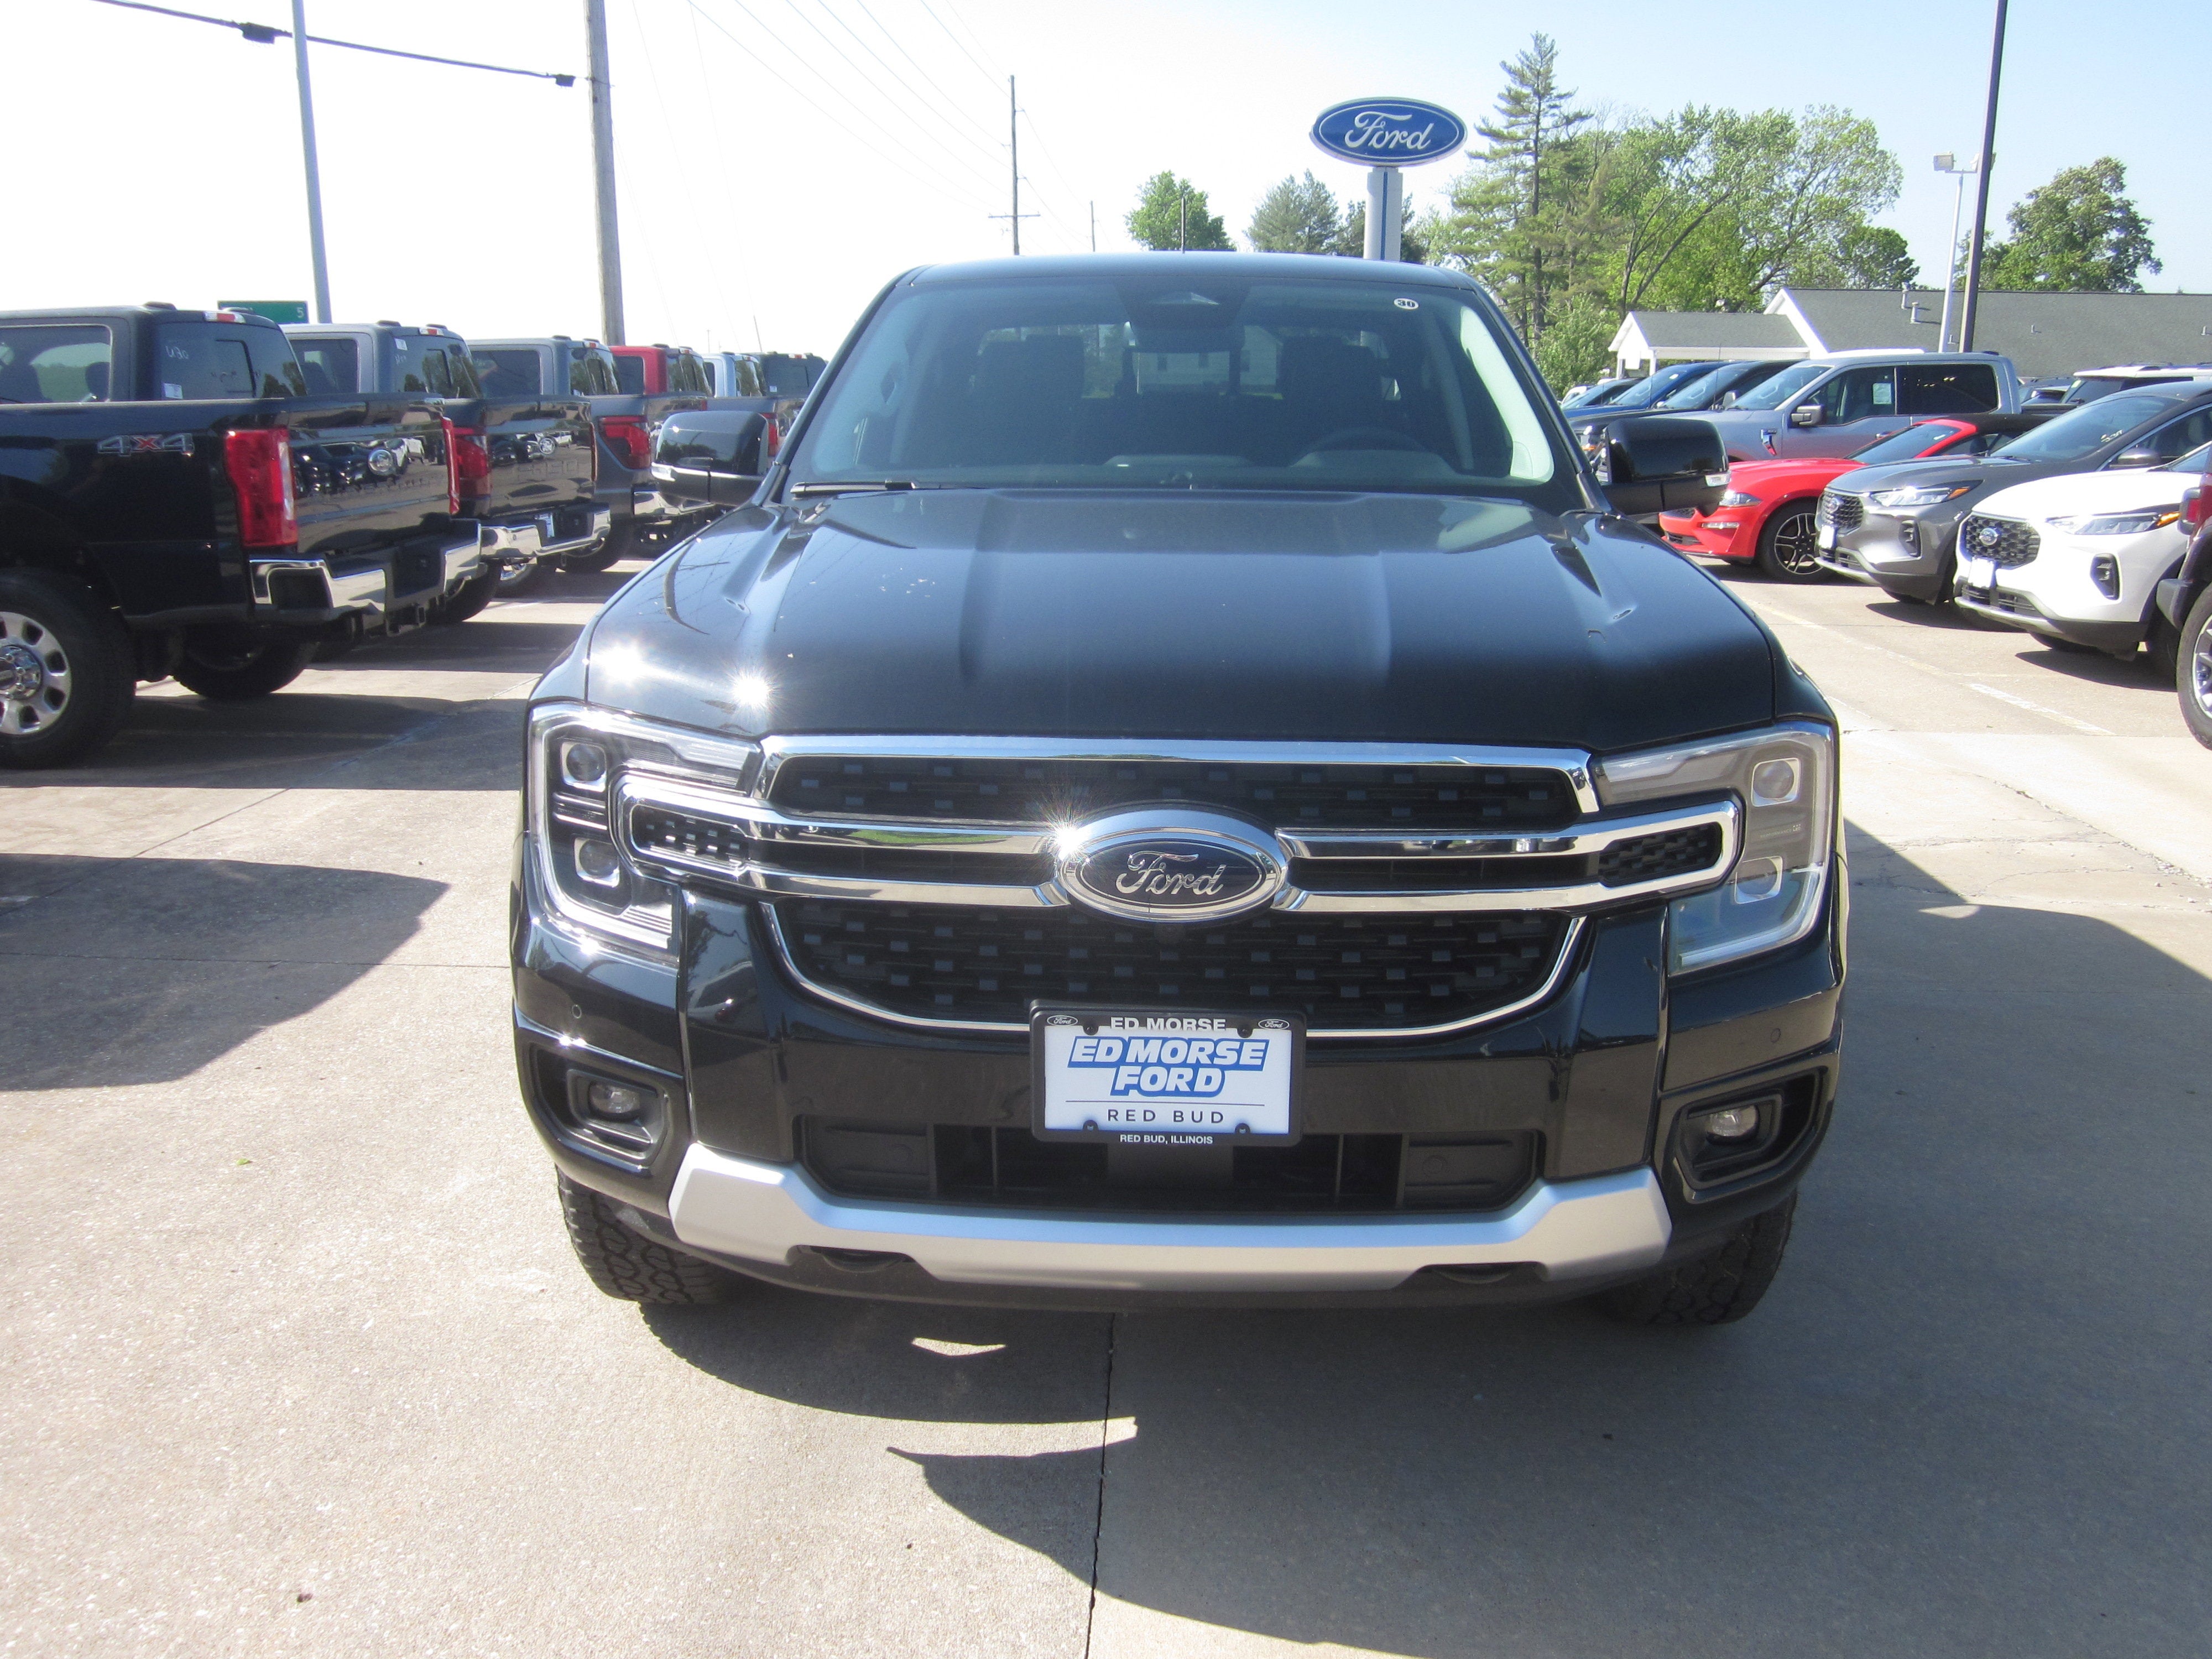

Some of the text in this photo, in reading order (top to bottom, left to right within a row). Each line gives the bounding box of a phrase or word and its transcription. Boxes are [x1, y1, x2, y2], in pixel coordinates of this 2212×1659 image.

[1345, 111, 1434, 150] Ford
[297, 307, 305, 319] 5
[1116, 851, 1226, 895] Ford
[1111, 1017, 1226, 1031] ED MORSE
[1265, 1020, 1283, 1029] Ford
[1068, 1037, 1268, 1069] ED MORSE
[1113, 1066, 1224, 1095] FORD
[1108, 1109, 1224, 1123] RED BUD
[1120, 1134, 1213, 1145] RED BUD, ILLINOIS
